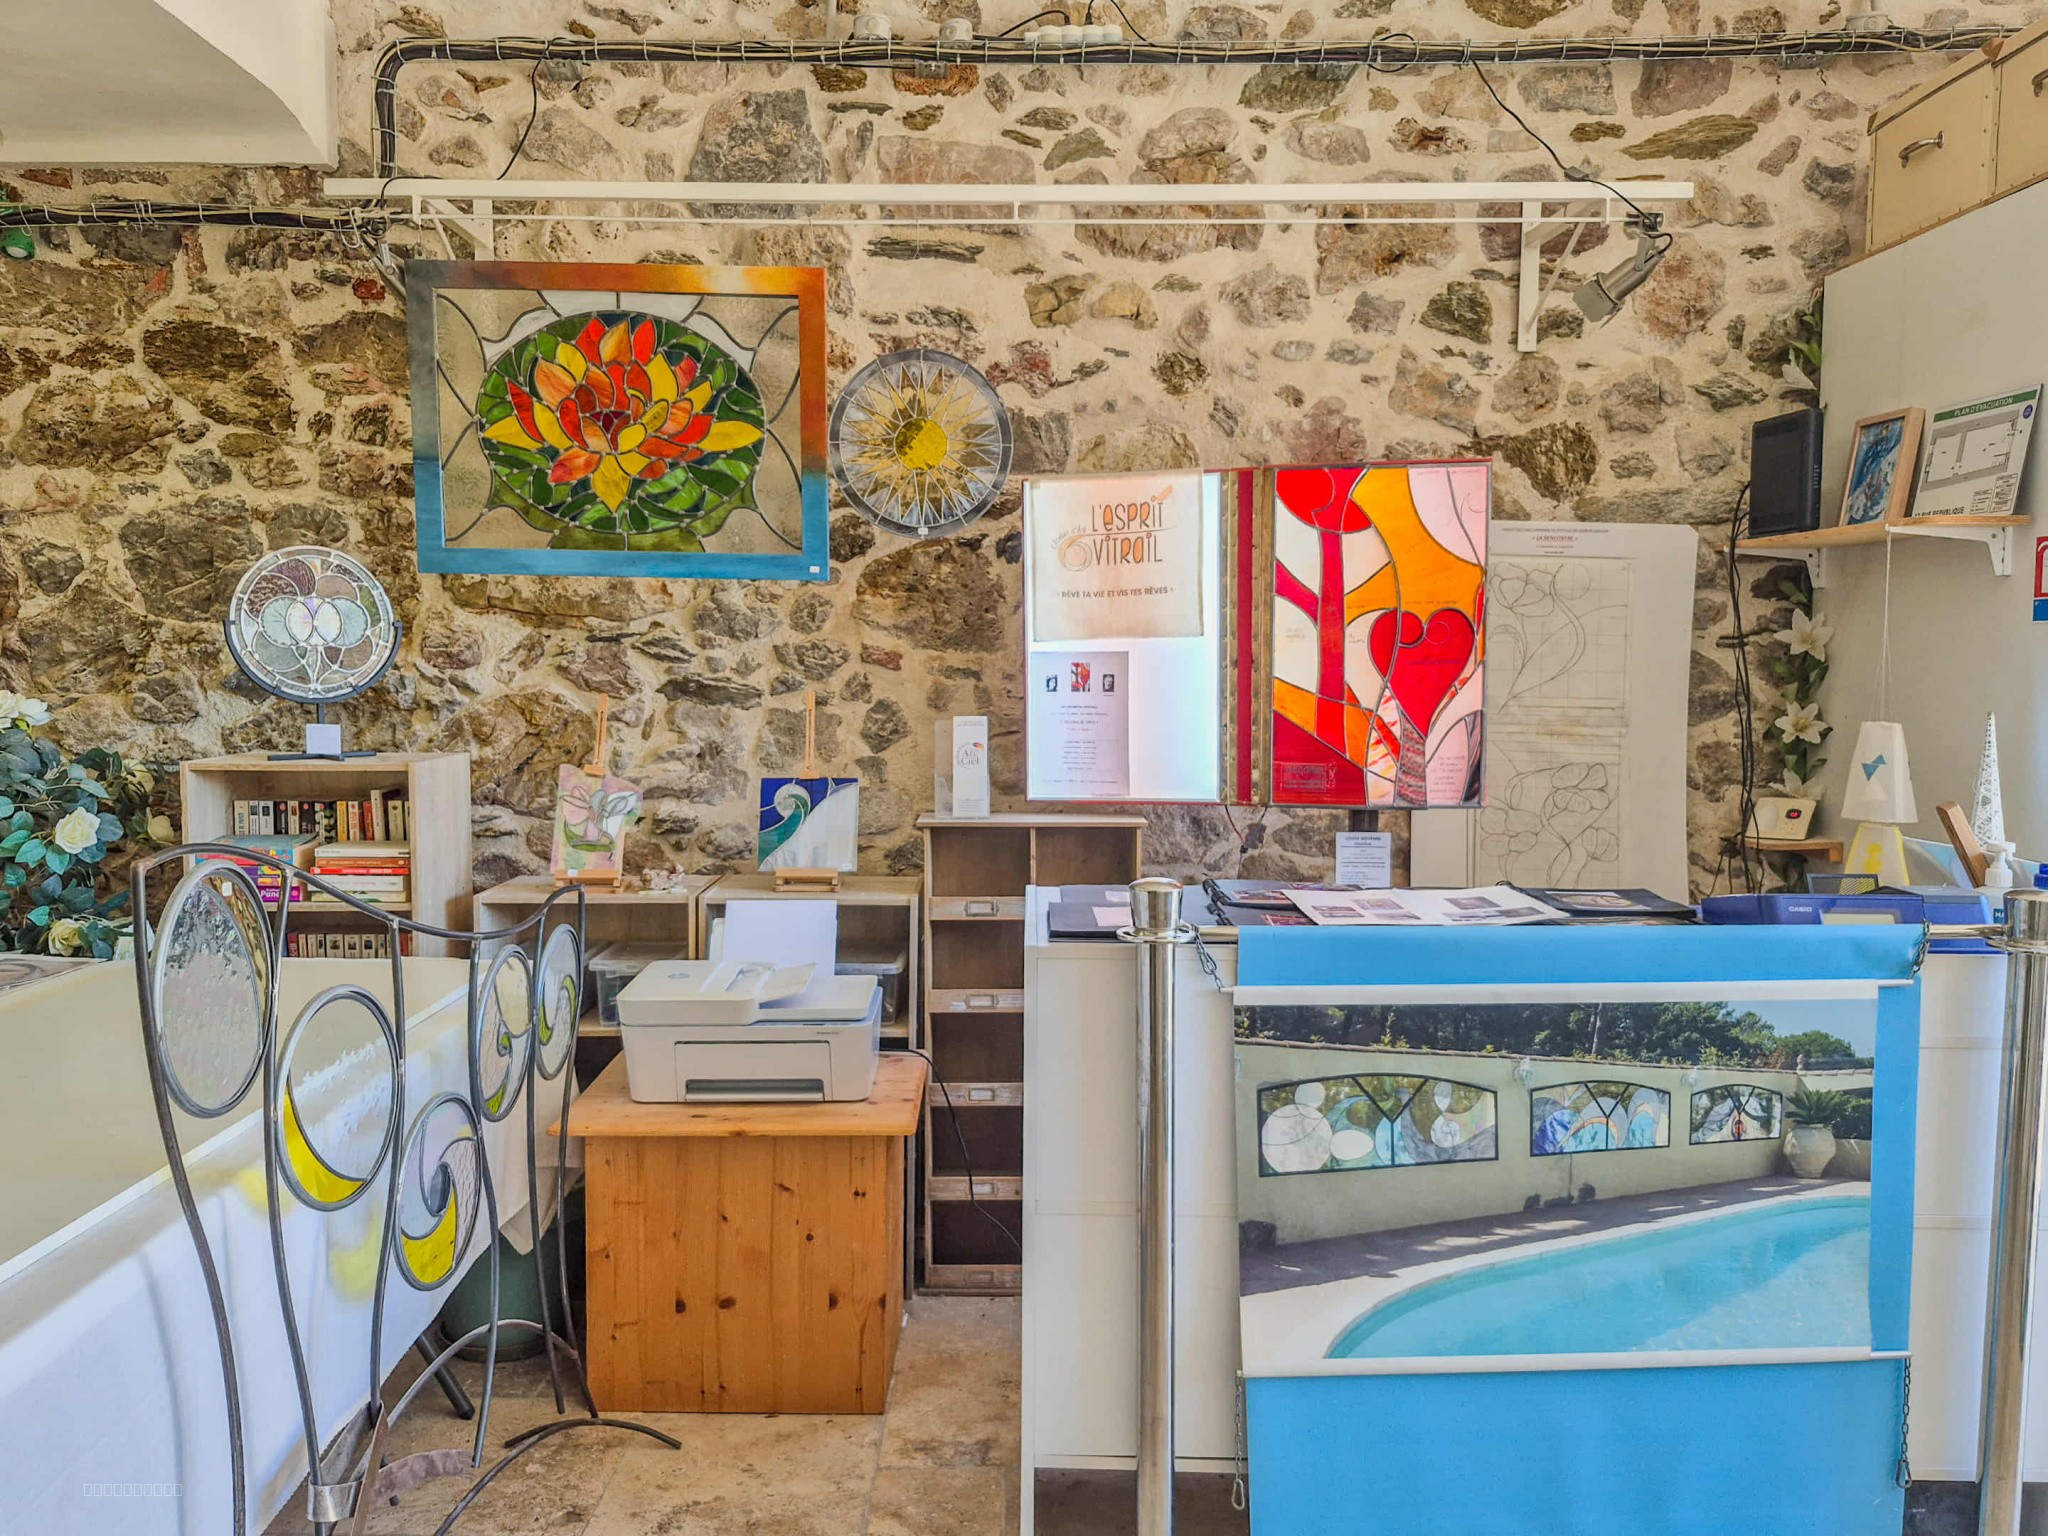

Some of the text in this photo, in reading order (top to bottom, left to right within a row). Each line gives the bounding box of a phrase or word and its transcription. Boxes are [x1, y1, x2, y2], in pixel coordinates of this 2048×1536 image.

[1954, 408, 1970, 417] PLAN
[1061, 585, 1168, 598] RÊVE TA VIE ET VIS TES RÊVES
